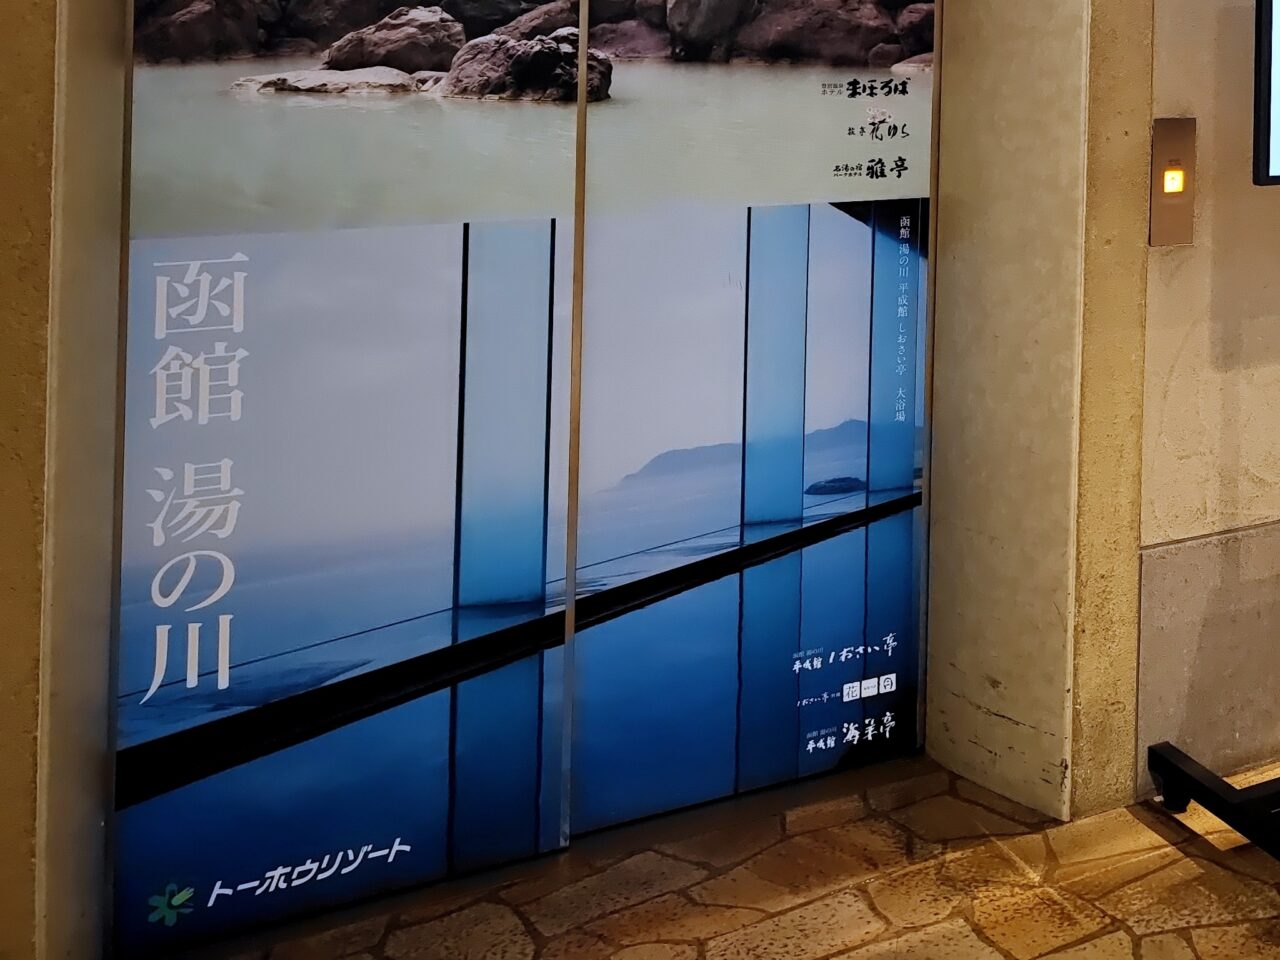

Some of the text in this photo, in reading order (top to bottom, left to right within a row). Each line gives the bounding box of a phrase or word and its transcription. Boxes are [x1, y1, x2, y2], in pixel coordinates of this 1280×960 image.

[899, 243, 910, 277] 湯の川
[140, 252, 249, 706] 函館 湯の川
[207, 837, 411, 907] トーホウリゾート
